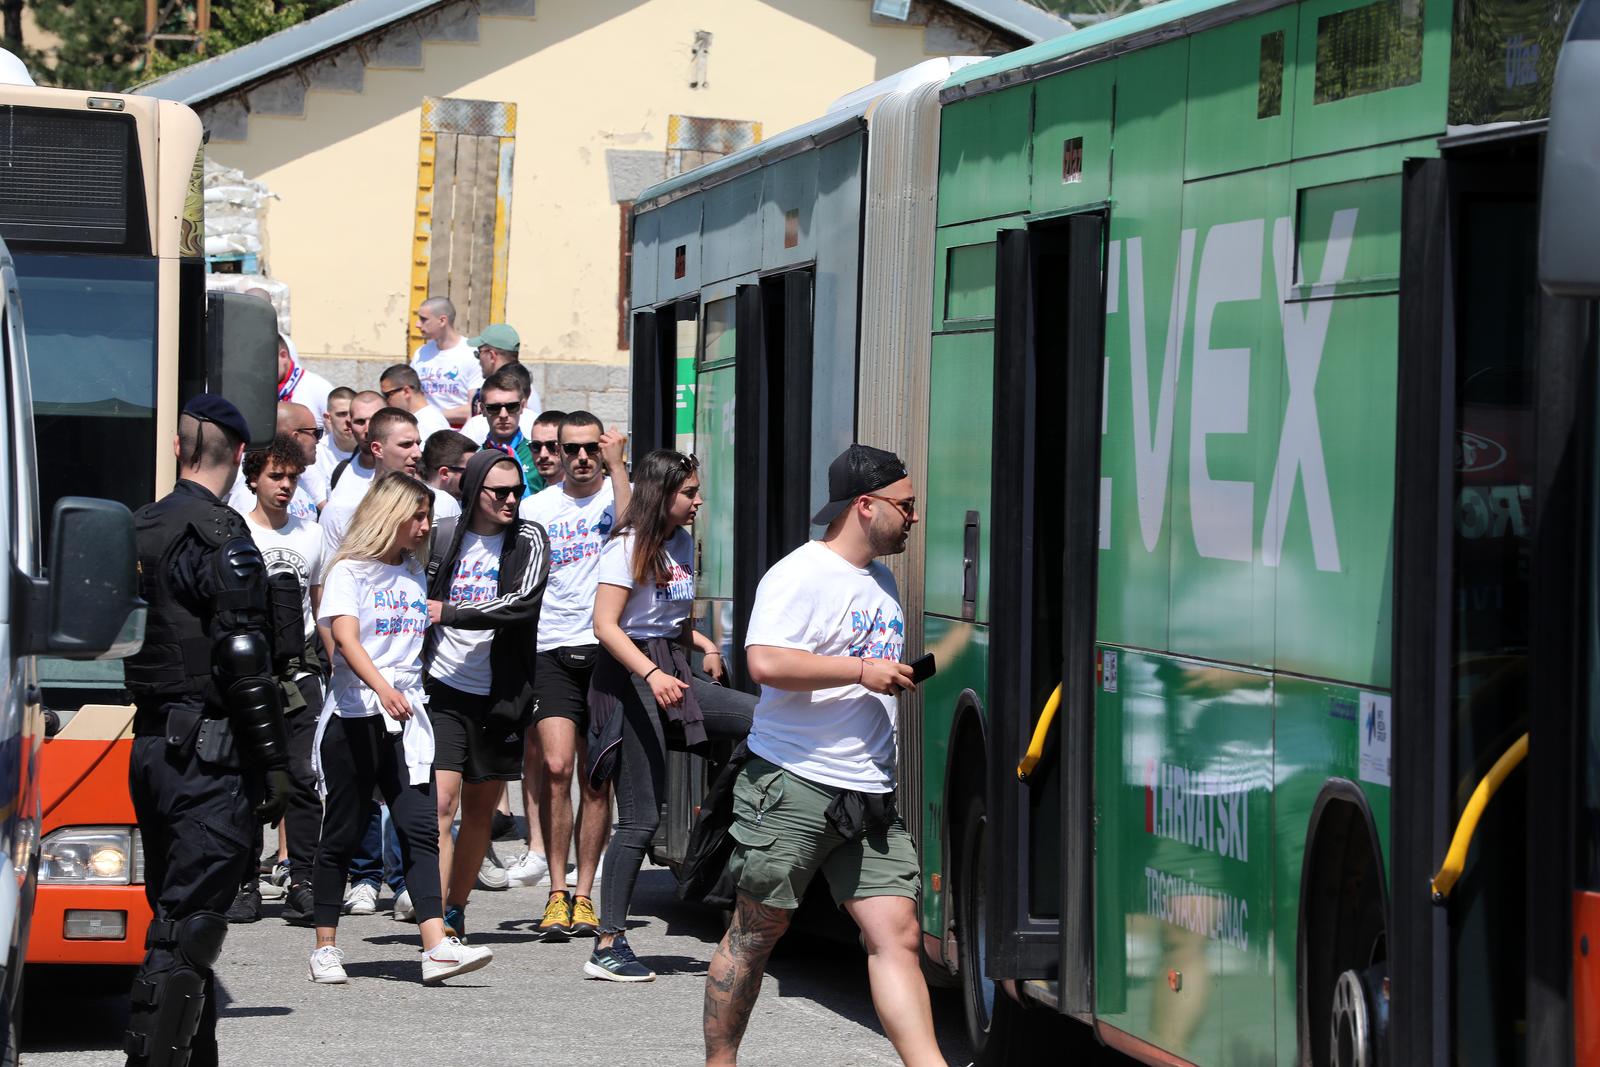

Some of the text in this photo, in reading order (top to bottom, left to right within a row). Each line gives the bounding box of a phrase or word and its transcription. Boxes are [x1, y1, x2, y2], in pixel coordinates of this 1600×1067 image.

[1099, 208, 1359, 572] VEX
[547, 518, 589, 540] BILE
[374, 590, 409, 611] BILE
[851, 607, 887, 635] BILE
[1210, 888, 1249, 953] LANAC
